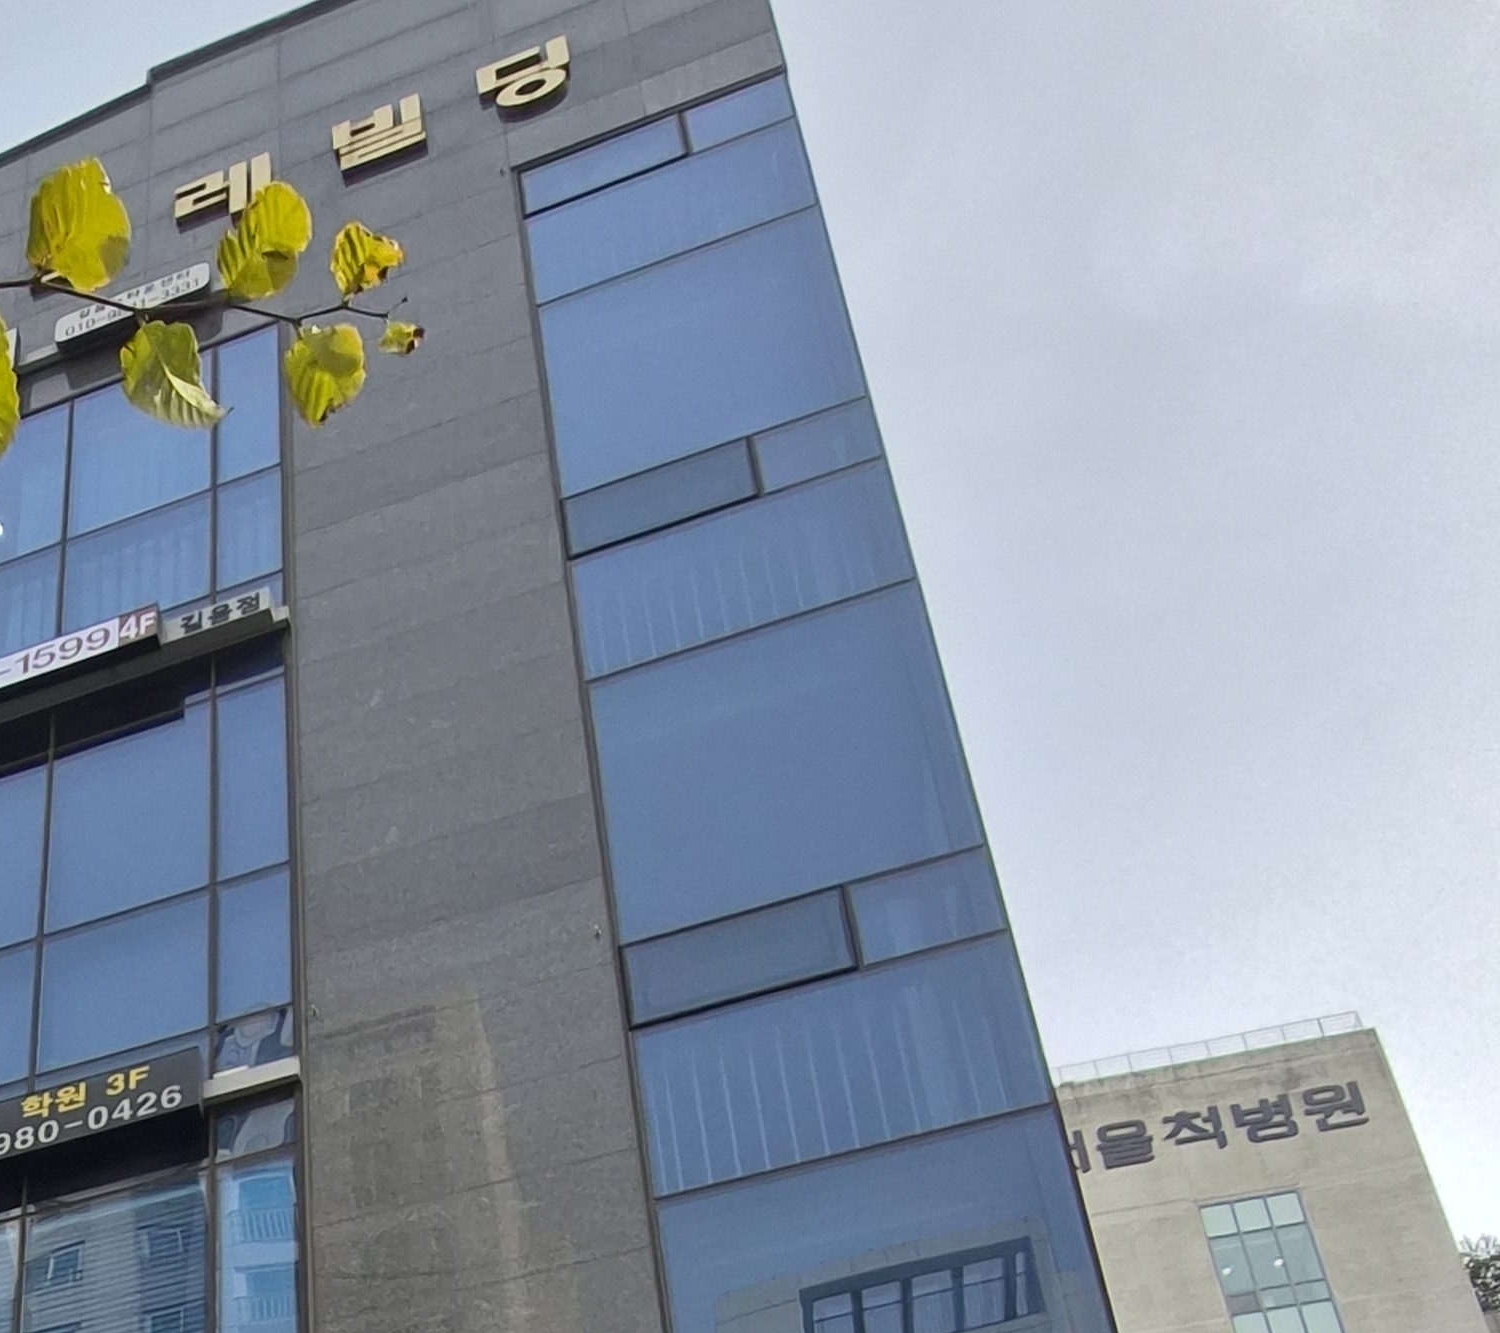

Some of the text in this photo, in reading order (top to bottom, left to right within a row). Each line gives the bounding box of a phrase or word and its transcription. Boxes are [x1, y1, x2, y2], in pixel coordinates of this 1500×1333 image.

[118, 612, 156, 640] 4F
[179, 590, 262, 635] 길음점
[20, 1065, 150, 1118] 학원 3F
